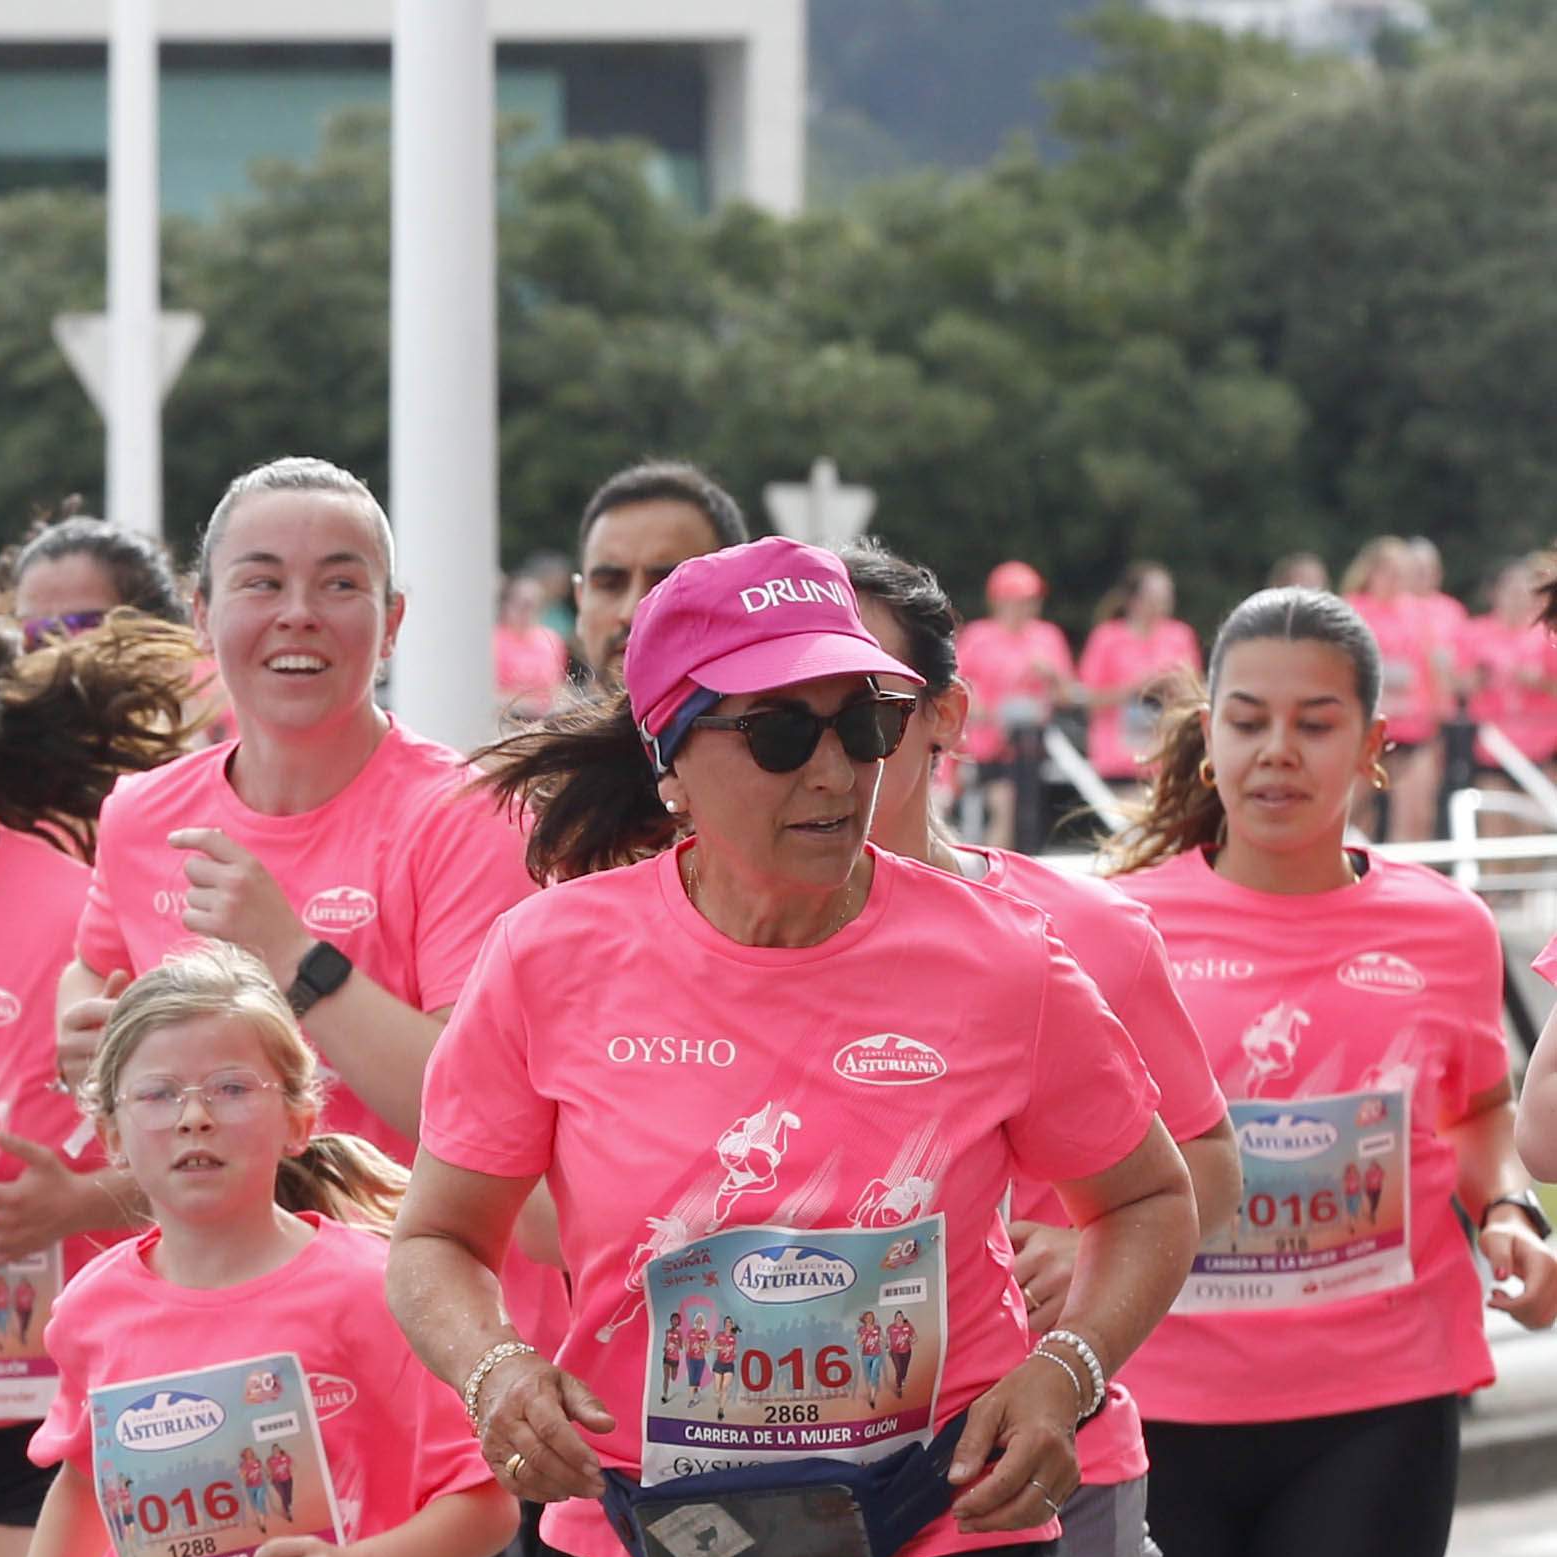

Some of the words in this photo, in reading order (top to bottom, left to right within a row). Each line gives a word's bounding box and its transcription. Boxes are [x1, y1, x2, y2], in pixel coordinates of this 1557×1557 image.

[739, 577, 847, 614] DRUNI
[1171, 957, 1255, 979] YSHO
[606, 1036, 736, 1068] OYSHO
[1248, 1189, 1339, 1228] 016
[739, 1263, 847, 1290] ASTURIANA
[740, 1345, 853, 1393] 016
[121, 1409, 220, 1443] ASTURIANA
[764, 1405, 819, 1424] 2868
[684, 1425, 750, 1445] CARRERA
[754, 1431, 773, 1445] DE
[777, 1432, 797, 1445] LA
[801, 1427, 852, 1445] MUJER
[138, 1480, 240, 1534] 016
